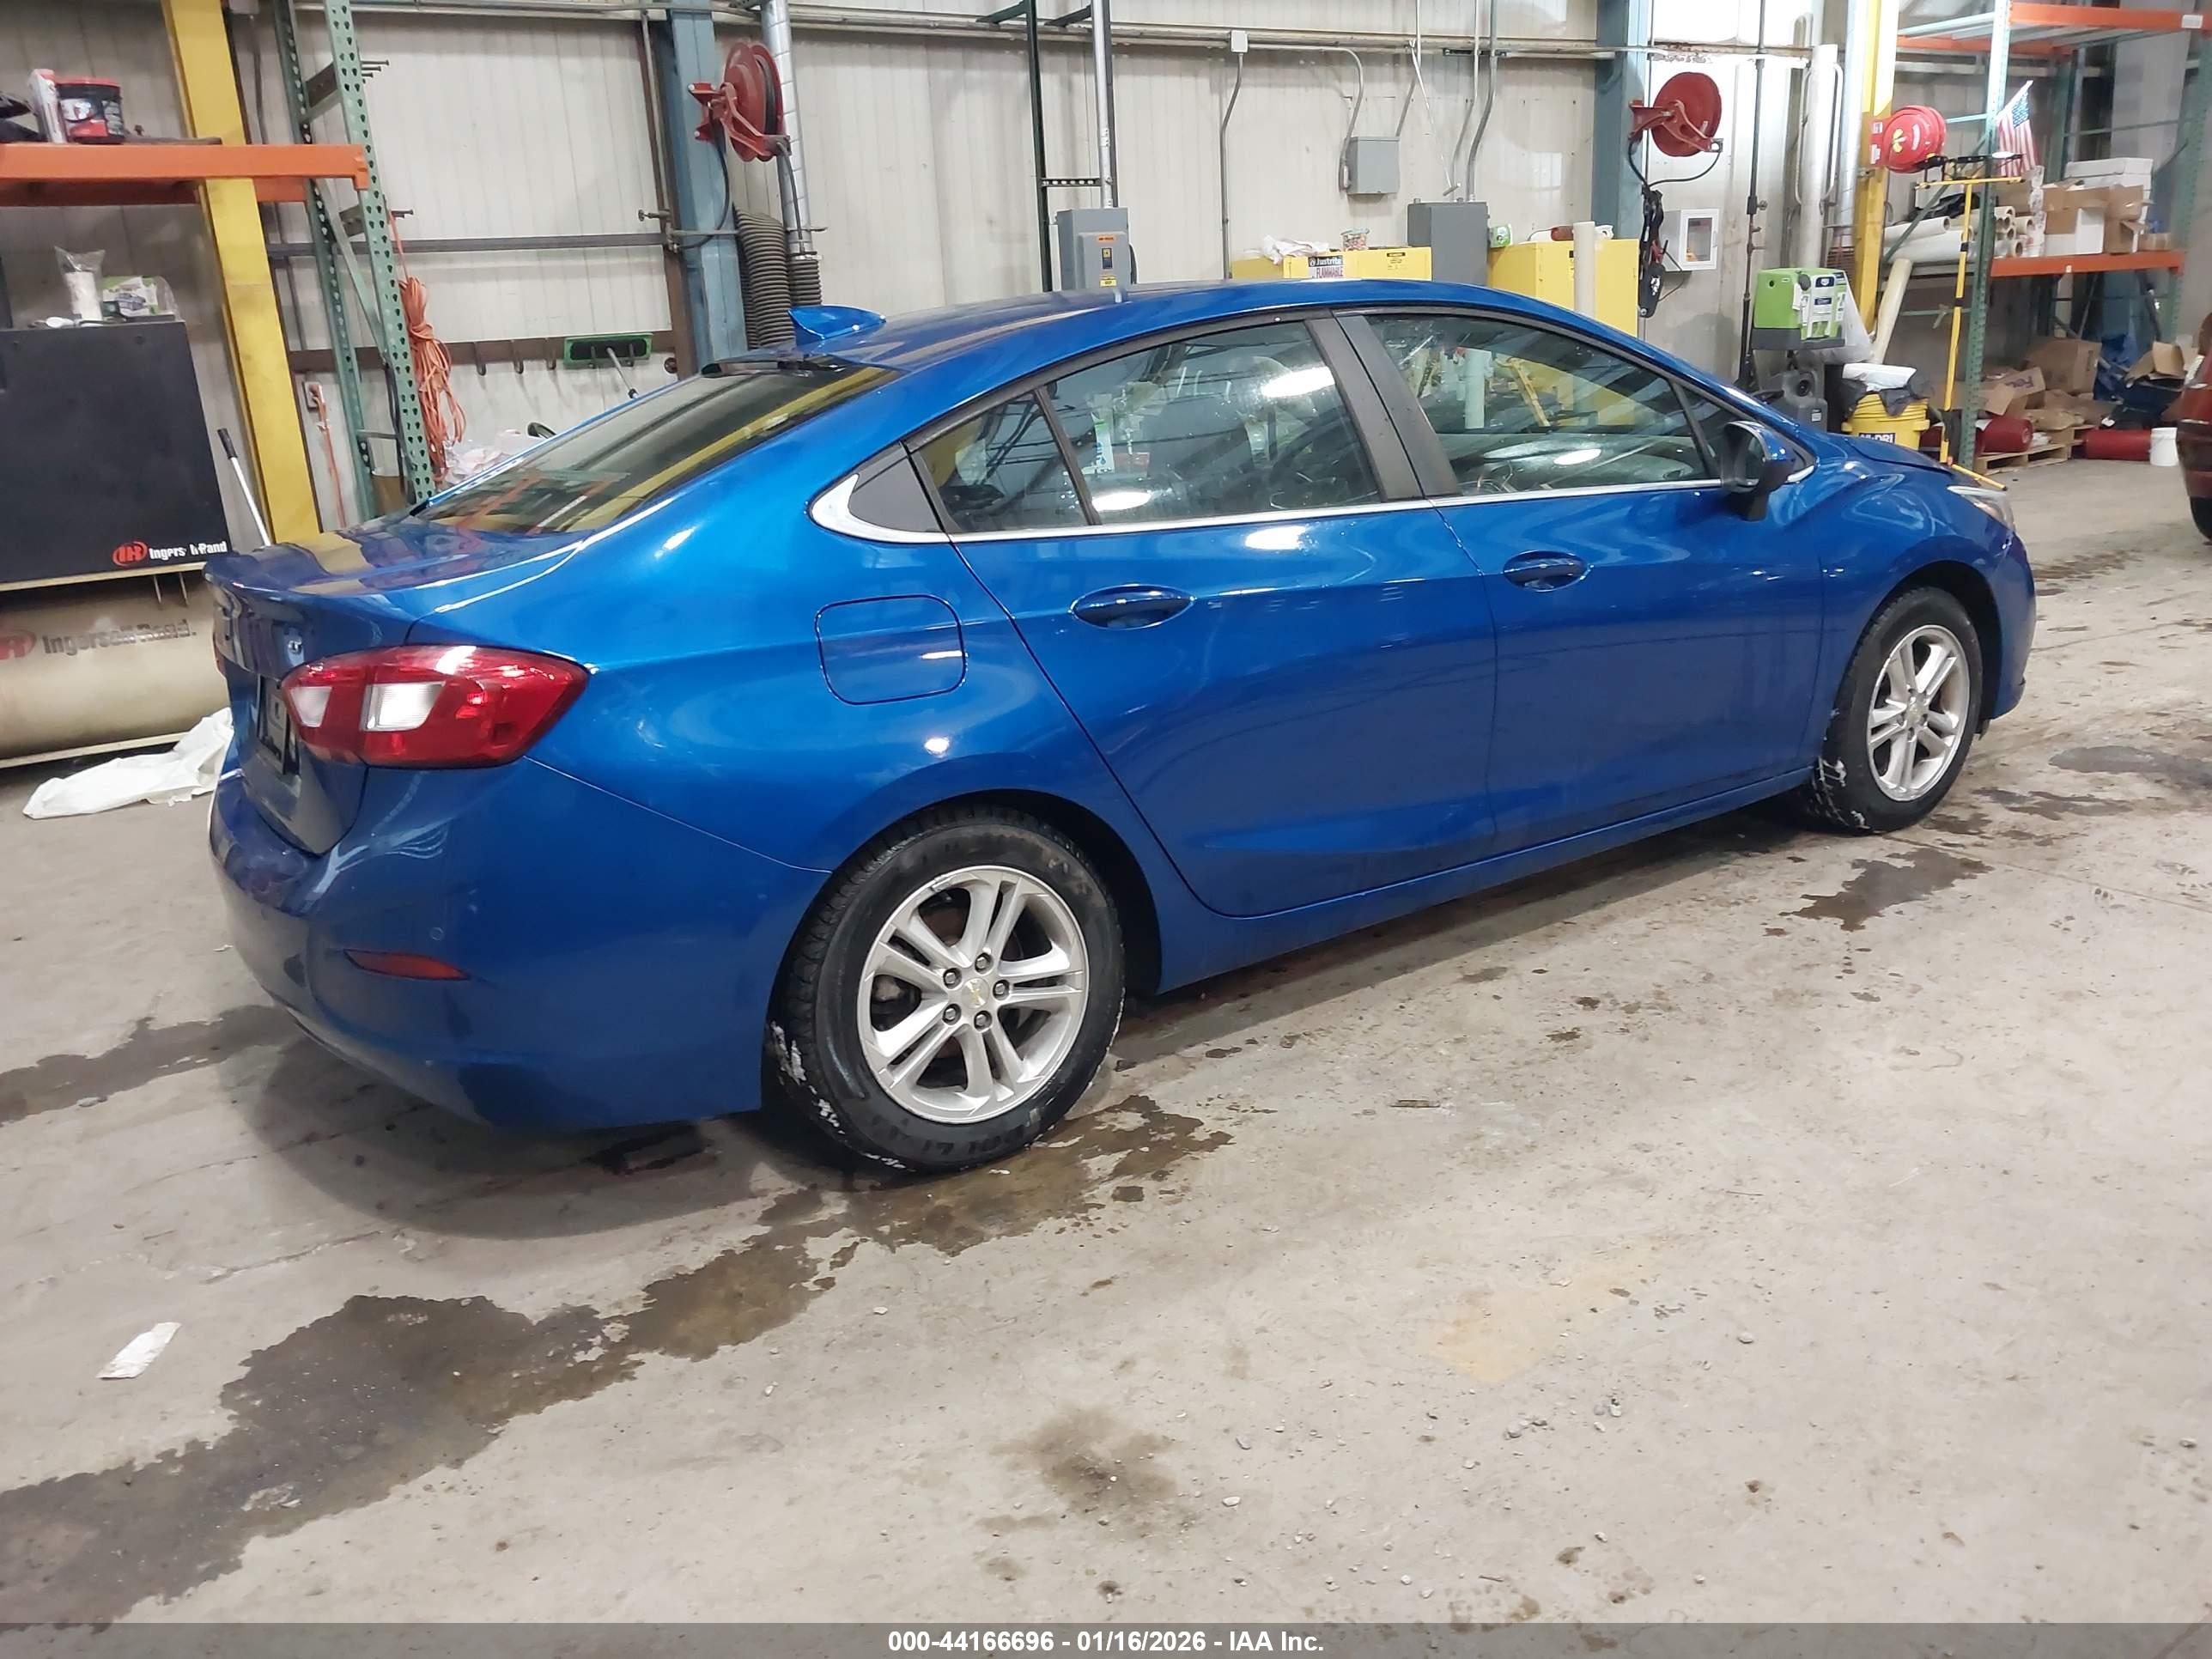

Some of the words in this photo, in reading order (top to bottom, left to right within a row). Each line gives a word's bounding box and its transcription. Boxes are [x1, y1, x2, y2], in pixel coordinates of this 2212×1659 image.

[1316, 257, 1341, 265] Justrite
[149, 544, 198, 561] Ingersll
[42, 624, 136, 656] Ingersoll
